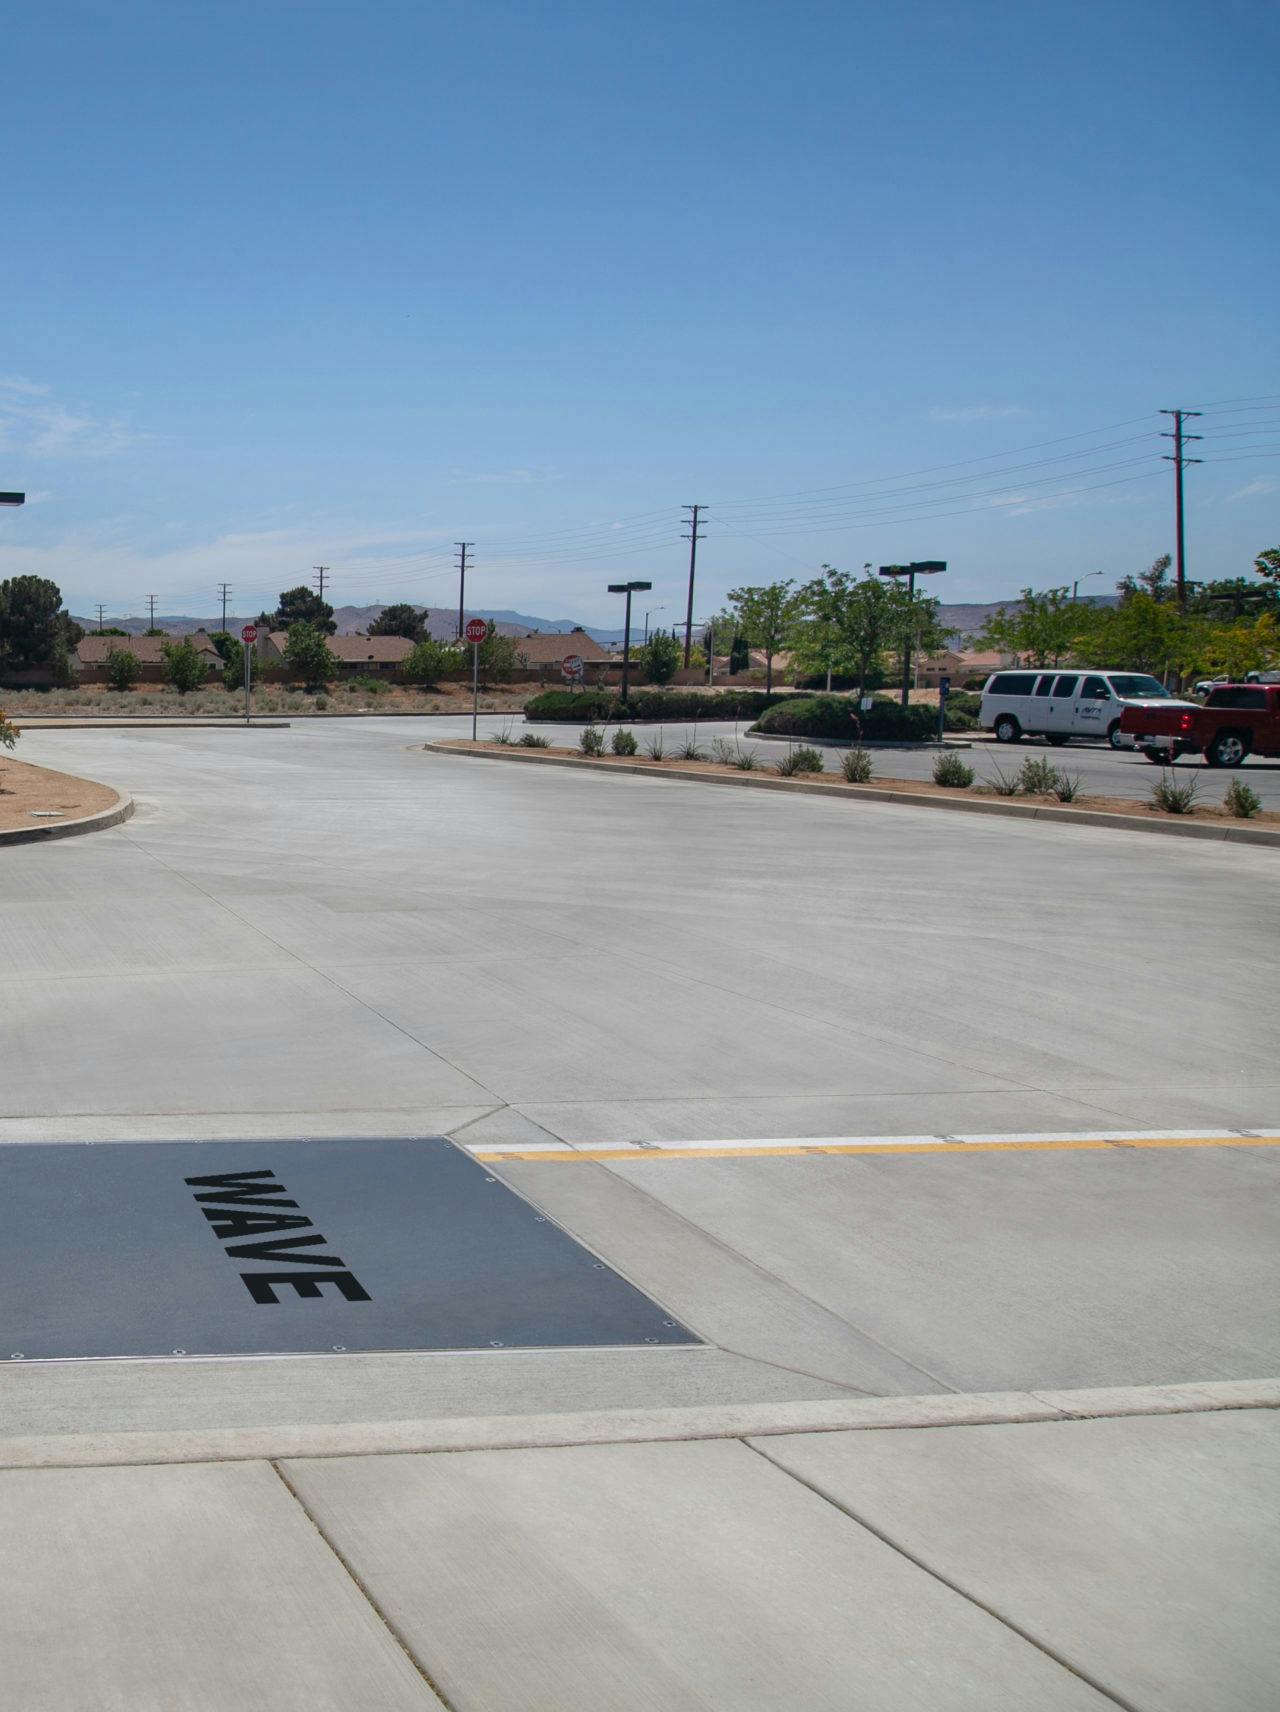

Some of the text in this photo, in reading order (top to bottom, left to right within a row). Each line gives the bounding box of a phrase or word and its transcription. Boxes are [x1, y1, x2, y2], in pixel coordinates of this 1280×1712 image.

[242, 630, 257, 638] STOP
[467, 626, 486, 636] STOP
[184, 1169, 373, 1304] WAVE
